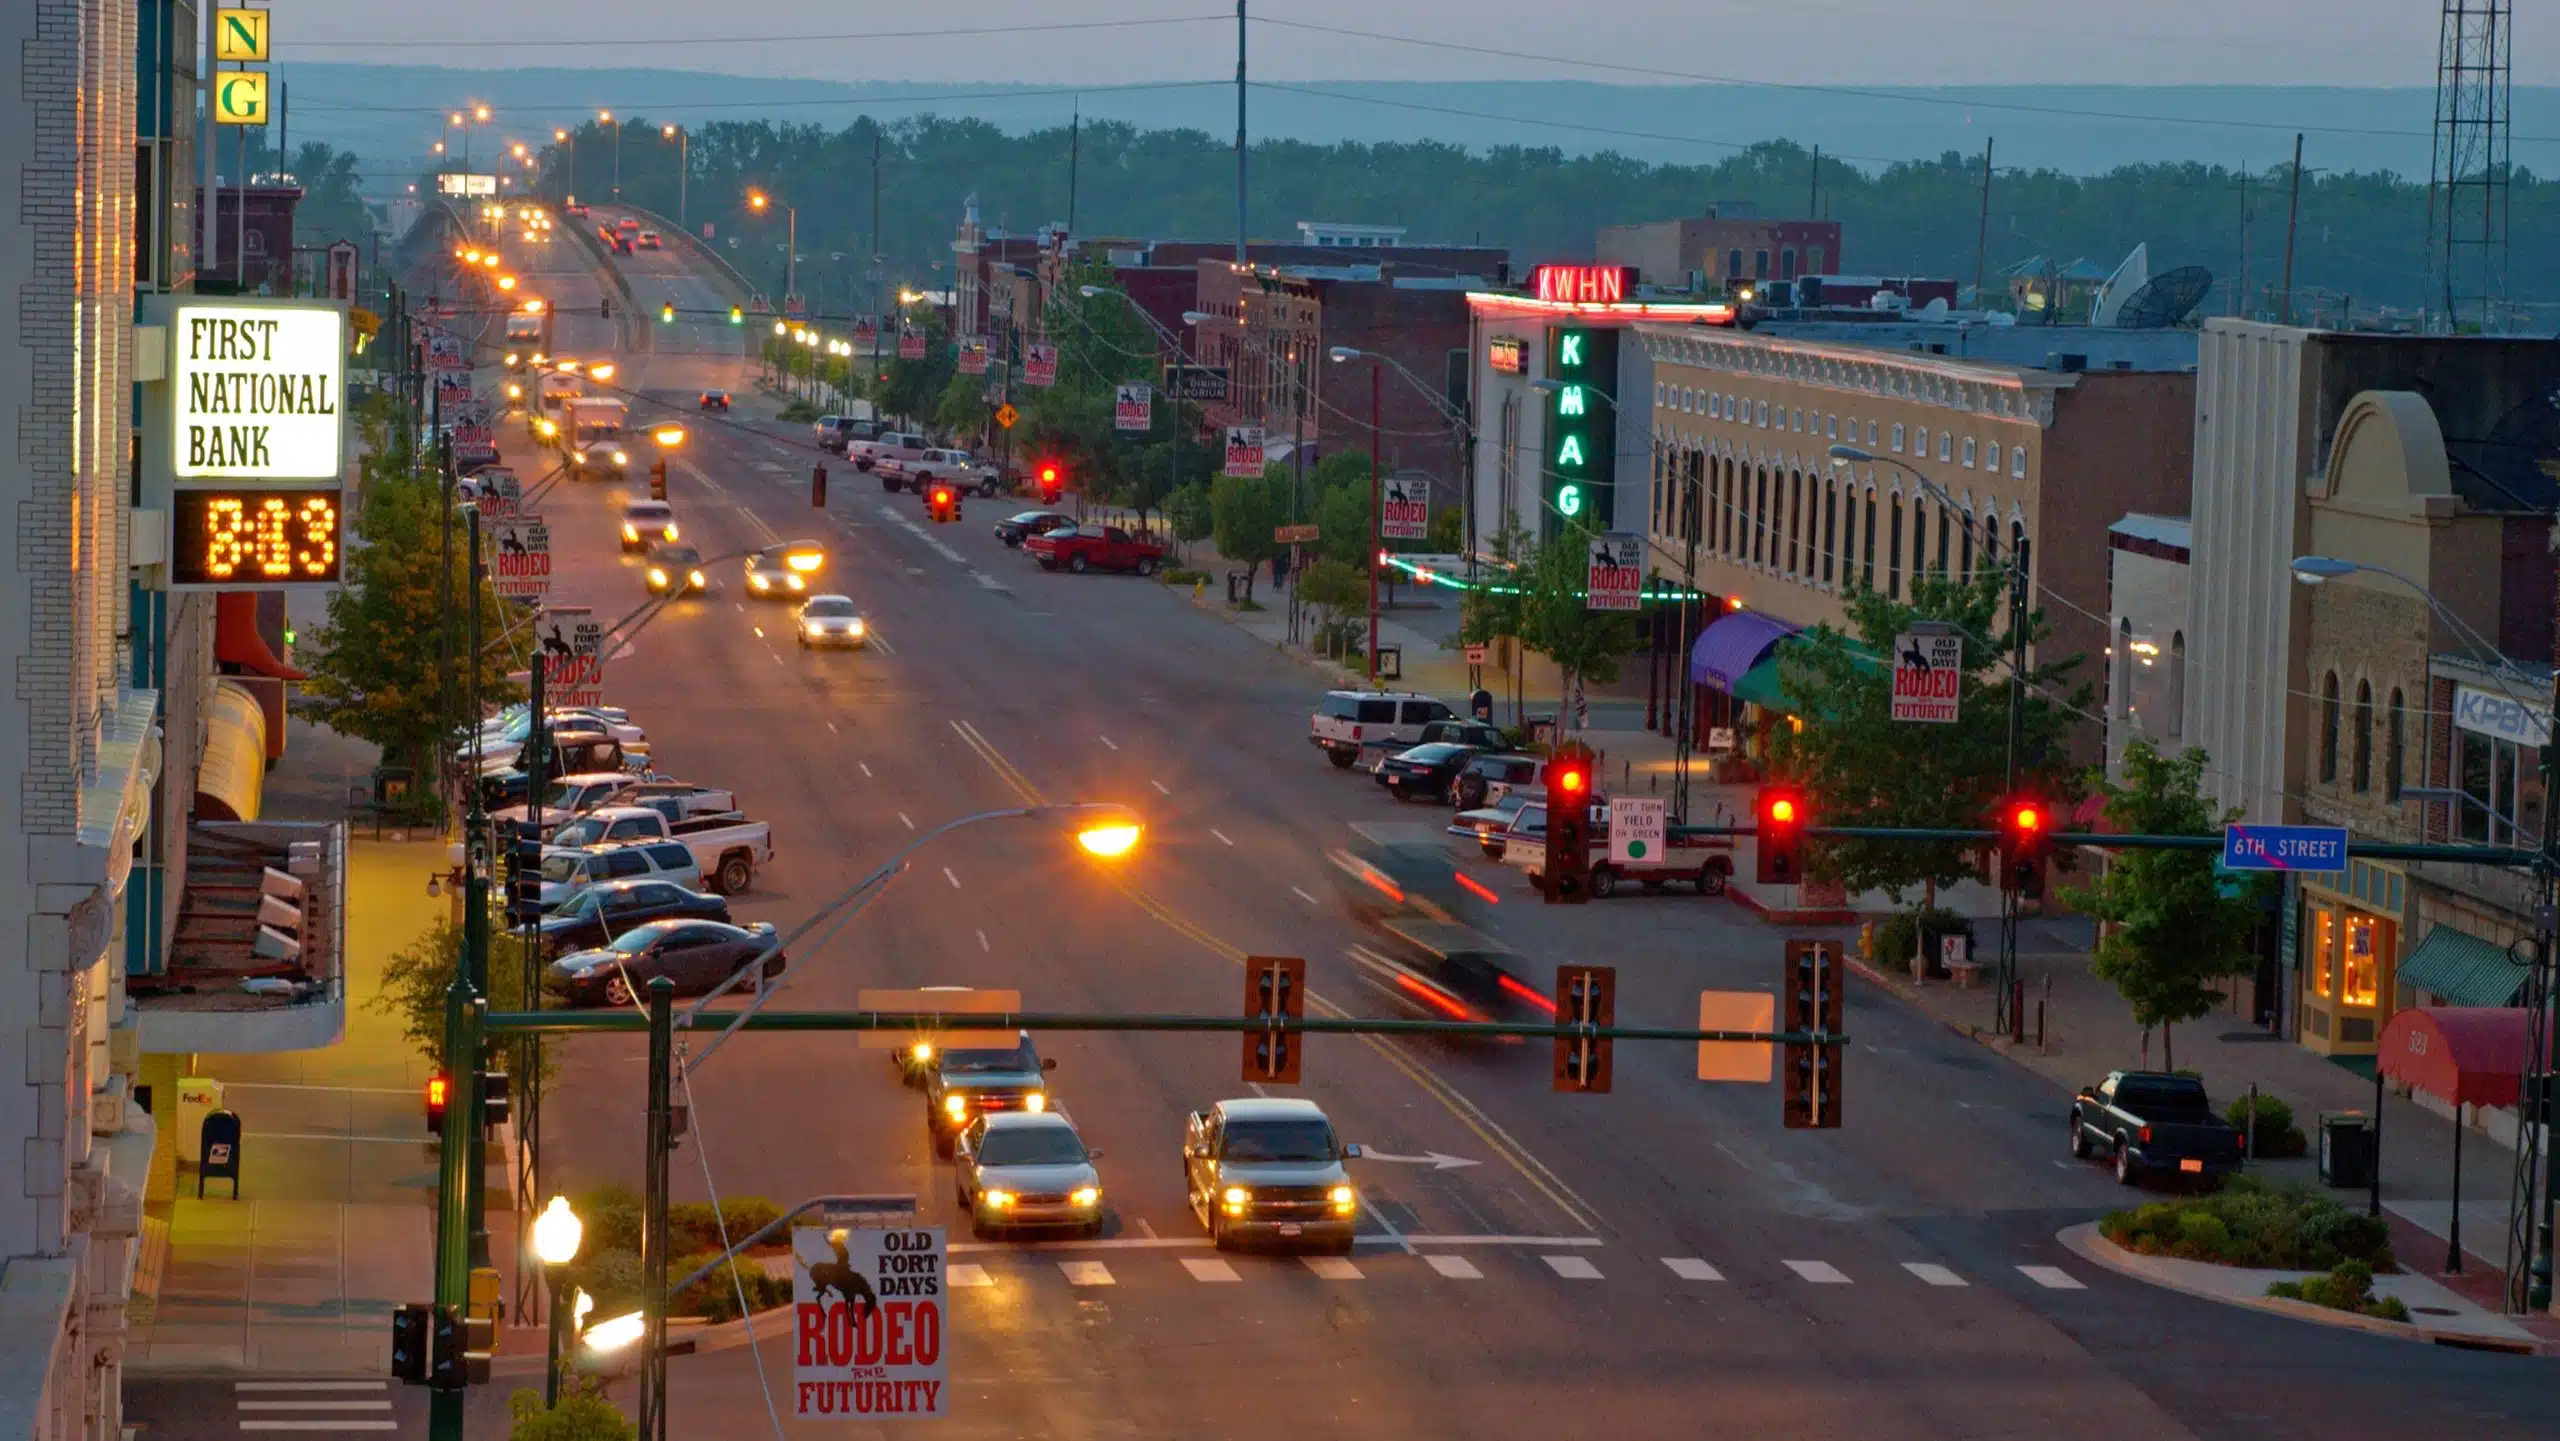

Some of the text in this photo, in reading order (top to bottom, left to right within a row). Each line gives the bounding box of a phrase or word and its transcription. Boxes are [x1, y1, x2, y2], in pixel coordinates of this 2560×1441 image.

[1538, 267, 1621, 300] KWHN
[190, 318, 278, 361] FIRST
[1190, 379, 1226, 388] DINING
[189, 371, 335, 415] NATIONAL
[1118, 401, 1149, 417] RODEO
[1558, 334, 1584, 516] KMAG
[188, 425, 270, 467] BANK
[1227, 446, 1263, 464] RODEO
[1384, 501, 1427, 523] RODEO
[1383, 525, 1425, 537] FUTURITY
[527, 543, 549, 551] DAYS
[498, 552, 550, 577] RODEO
[1590, 566, 1641, 591] RODEO
[499, 582, 550, 594] FUTURITY
[1588, 594, 1639, 609] FUTURITY
[576, 624, 599, 633] OLD
[574, 634, 601, 644] FORT
[1935, 639, 1956, 648] OLD
[1931, 648, 1958, 657] FORT
[1931, 658, 1957, 668] DAYS
[1894, 667, 1958, 698] RODEO
[1893, 703, 1957, 720] FUTURITY
[1614, 802, 1662, 812] LEFT TURN
[1624, 815, 1653, 826] YIELD
[1615, 828, 1660, 839] ON GREEN
[2234, 838, 2338, 858] 6TH STREET
[183, 1092, 213, 1104] FedEx
[884, 1232, 932, 1251] OLD
[878, 1254, 938, 1274] FORT
[879, 1276, 939, 1296] DAYS
[797, 1300, 941, 1367] RODEO
[798, 1380, 941, 1414] FUTURITY
